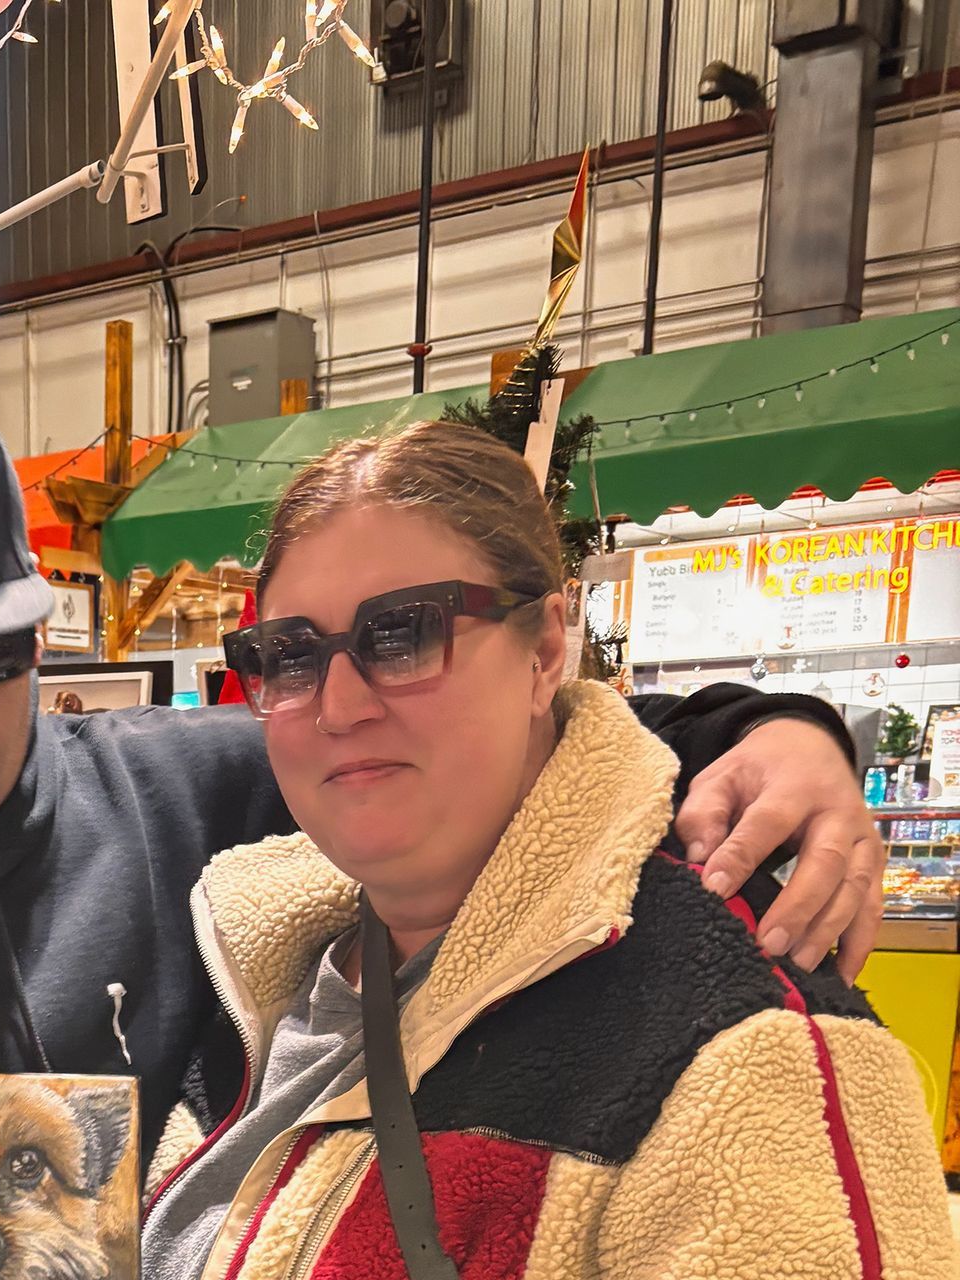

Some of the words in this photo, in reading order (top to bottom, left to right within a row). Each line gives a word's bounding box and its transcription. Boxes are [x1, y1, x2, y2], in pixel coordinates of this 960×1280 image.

[692, 547, 744, 573] MJ's
[755, 531, 865, 567] KOREAN
[762, 573, 784, 598] &
[790, 564, 909, 595] Catering
